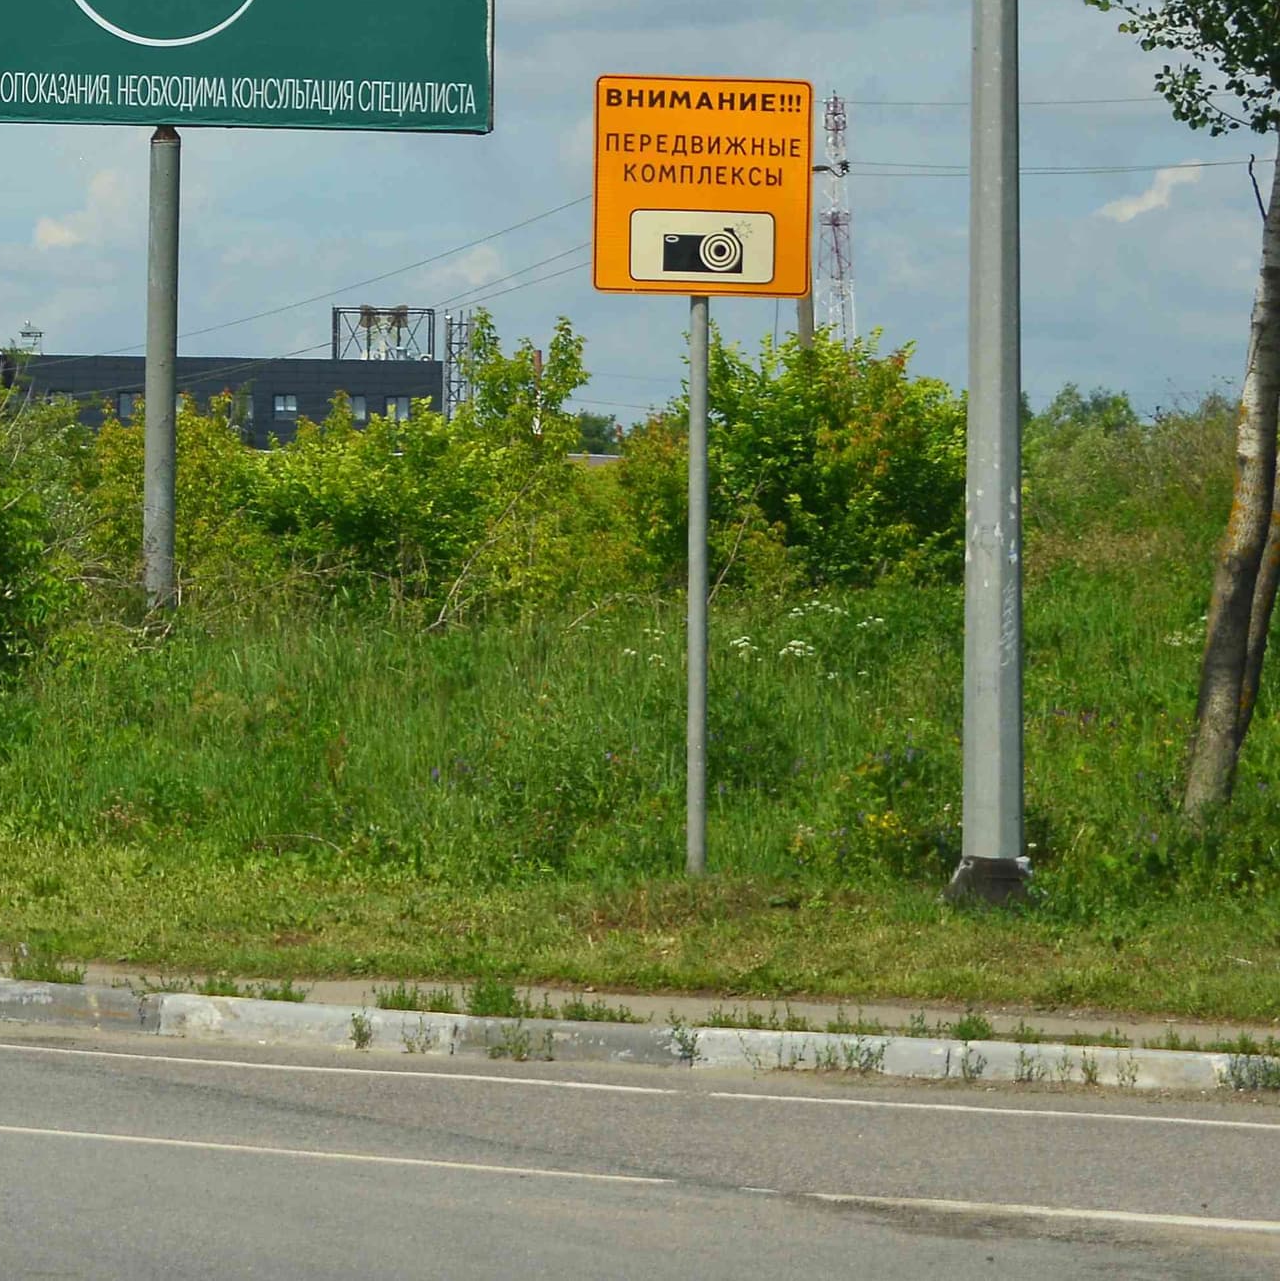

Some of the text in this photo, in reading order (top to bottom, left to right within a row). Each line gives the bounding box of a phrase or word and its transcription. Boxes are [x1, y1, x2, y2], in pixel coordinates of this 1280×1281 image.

[117, 74, 227, 111] НЕОБХОДИМА
[231, 77, 354, 115] КОНСУЛЬТАЦИЯ
[358, 80, 477, 117] СПЕЦИАЛИСТА
[605, 88, 803, 113] ВНИМАНИЕ!!!
[605, 133, 801, 158] ПЕРЕДВИЖНЫЕ
[623, 163, 783, 186] КОМПЛЕКСЫ
